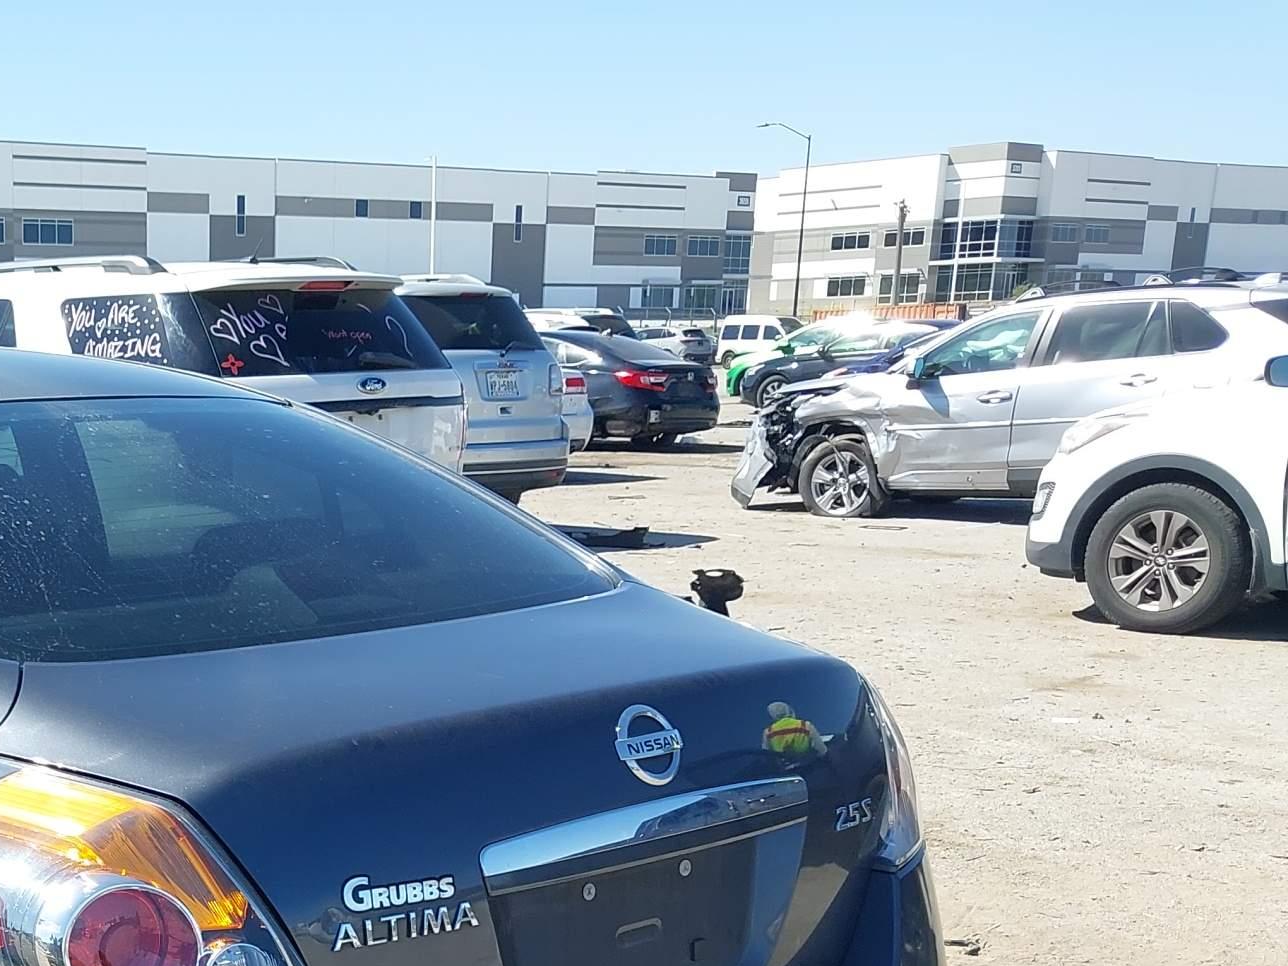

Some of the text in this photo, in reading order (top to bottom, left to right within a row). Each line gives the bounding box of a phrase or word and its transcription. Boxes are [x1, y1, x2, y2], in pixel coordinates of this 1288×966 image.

[107, 302, 141, 328] ARE
[84, 333, 162, 359] AMAZING
[626, 733, 679, 757] NISSAN
[333, 902, 480, 952] ALTIMA
